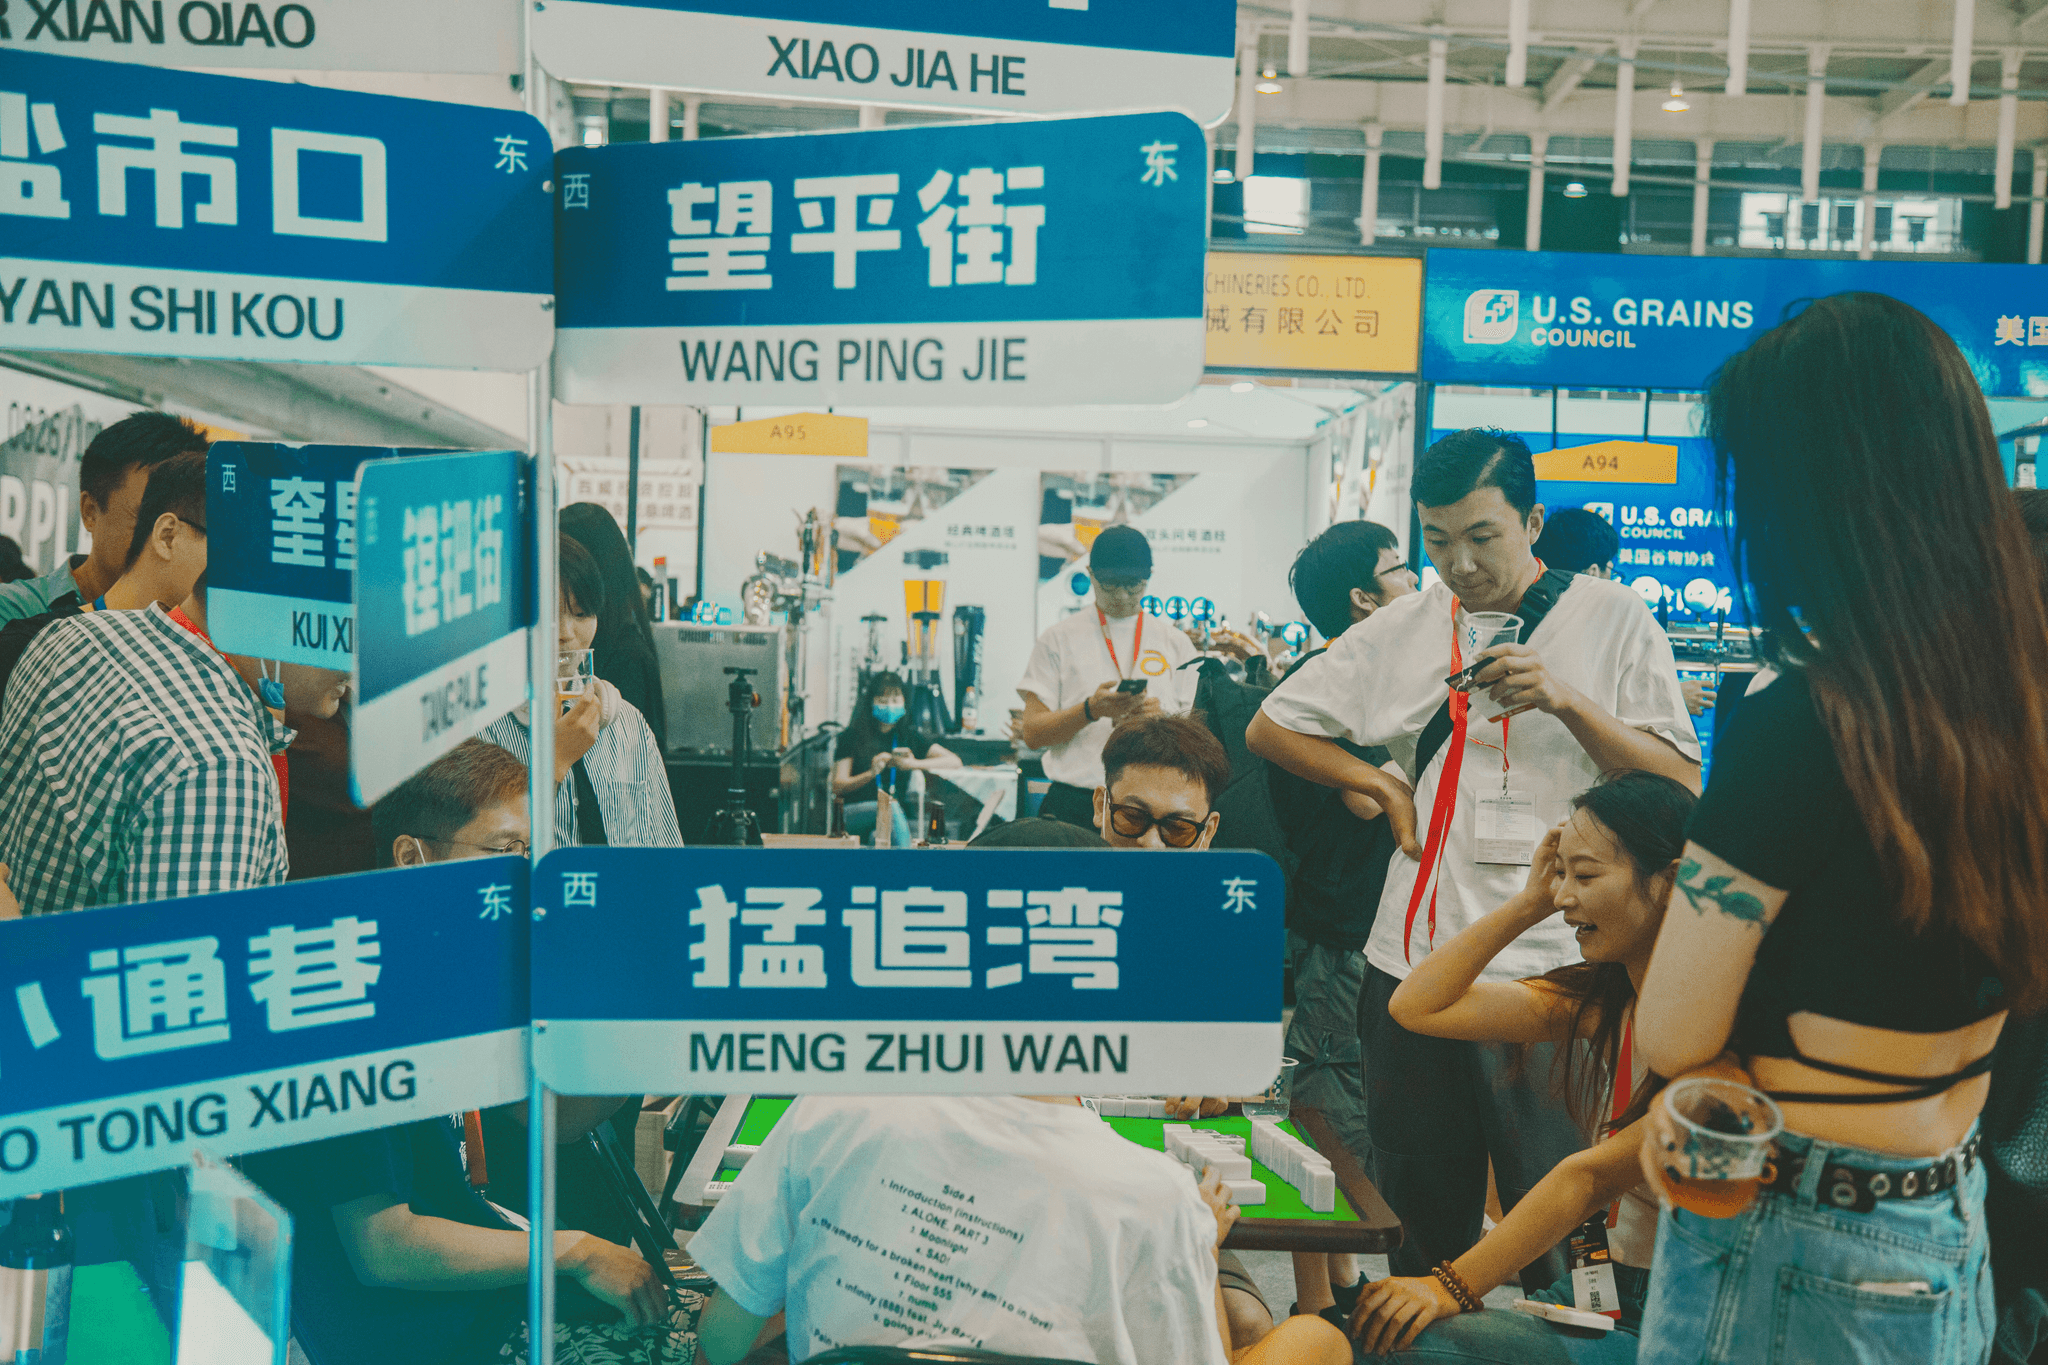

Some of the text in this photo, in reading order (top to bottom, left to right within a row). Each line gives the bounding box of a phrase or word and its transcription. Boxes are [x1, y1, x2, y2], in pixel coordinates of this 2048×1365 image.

[25, 0, 164, 44] XIAN
[178, 1, 316, 49] QIAO
[766, 36, 1026, 96] XIAO JIA HE
[493, 134, 529, 174] 东
[1140, 139, 1180, 187] 东
[563, 173, 591, 210] 西
[666, 166, 1046, 291] 望平街
[0, 277, 344, 342] YAN SHI KOU
[1205, 304, 1380, 338] 械有限公司
[1532, 296, 1754, 329] U.S. GRAINS
[1531, 327, 1637, 349] COUNCIL
[1994, 314, 2048, 347] 美国
[680, 337, 1027, 382] WANG PING JIE
[769, 424, 806, 442] A95
[221, 463, 237, 493] 西
[1582, 454, 1619, 471] A94
[1620, 505, 1667, 527] U.S.
[1620, 526, 1686, 540] COUNCIL
[292, 610, 327, 651] KUI
[477, 883, 513, 921] 东
[561, 872, 598, 907] 西
[1221, 876, 1258, 914] 东
[688, 884, 1124, 990] 猛追湾
[16, 916, 382, 1061] 通巷
[689, 1033, 1129, 1074] MENG ZHUI WAN
[58, 1092, 229, 1161] TONG
[248, 1059, 417, 1128] XIANG
[889, 1180, 954, 1214] Introduction
[954, 1207, 1025, 1244] (instructions)
[942, 1184, 975, 1205] Side A
[919, 1227, 969, 1255] Moonlight
[953, 1223, 982, 1241] PART
[832, 1225, 863, 1248] remedy
[865, 1239, 879, 1253] for
[889, 1251, 926, 1274] broken
[928, 1266, 954, 1286] heart
[926, 1248, 950, 1266] SAD!
[845, 1283, 877, 1306] infinity
[904, 1273, 931, 1292] Floor
[908, 1294, 938, 1313] numb
[883, 1317, 914, 1337] going
